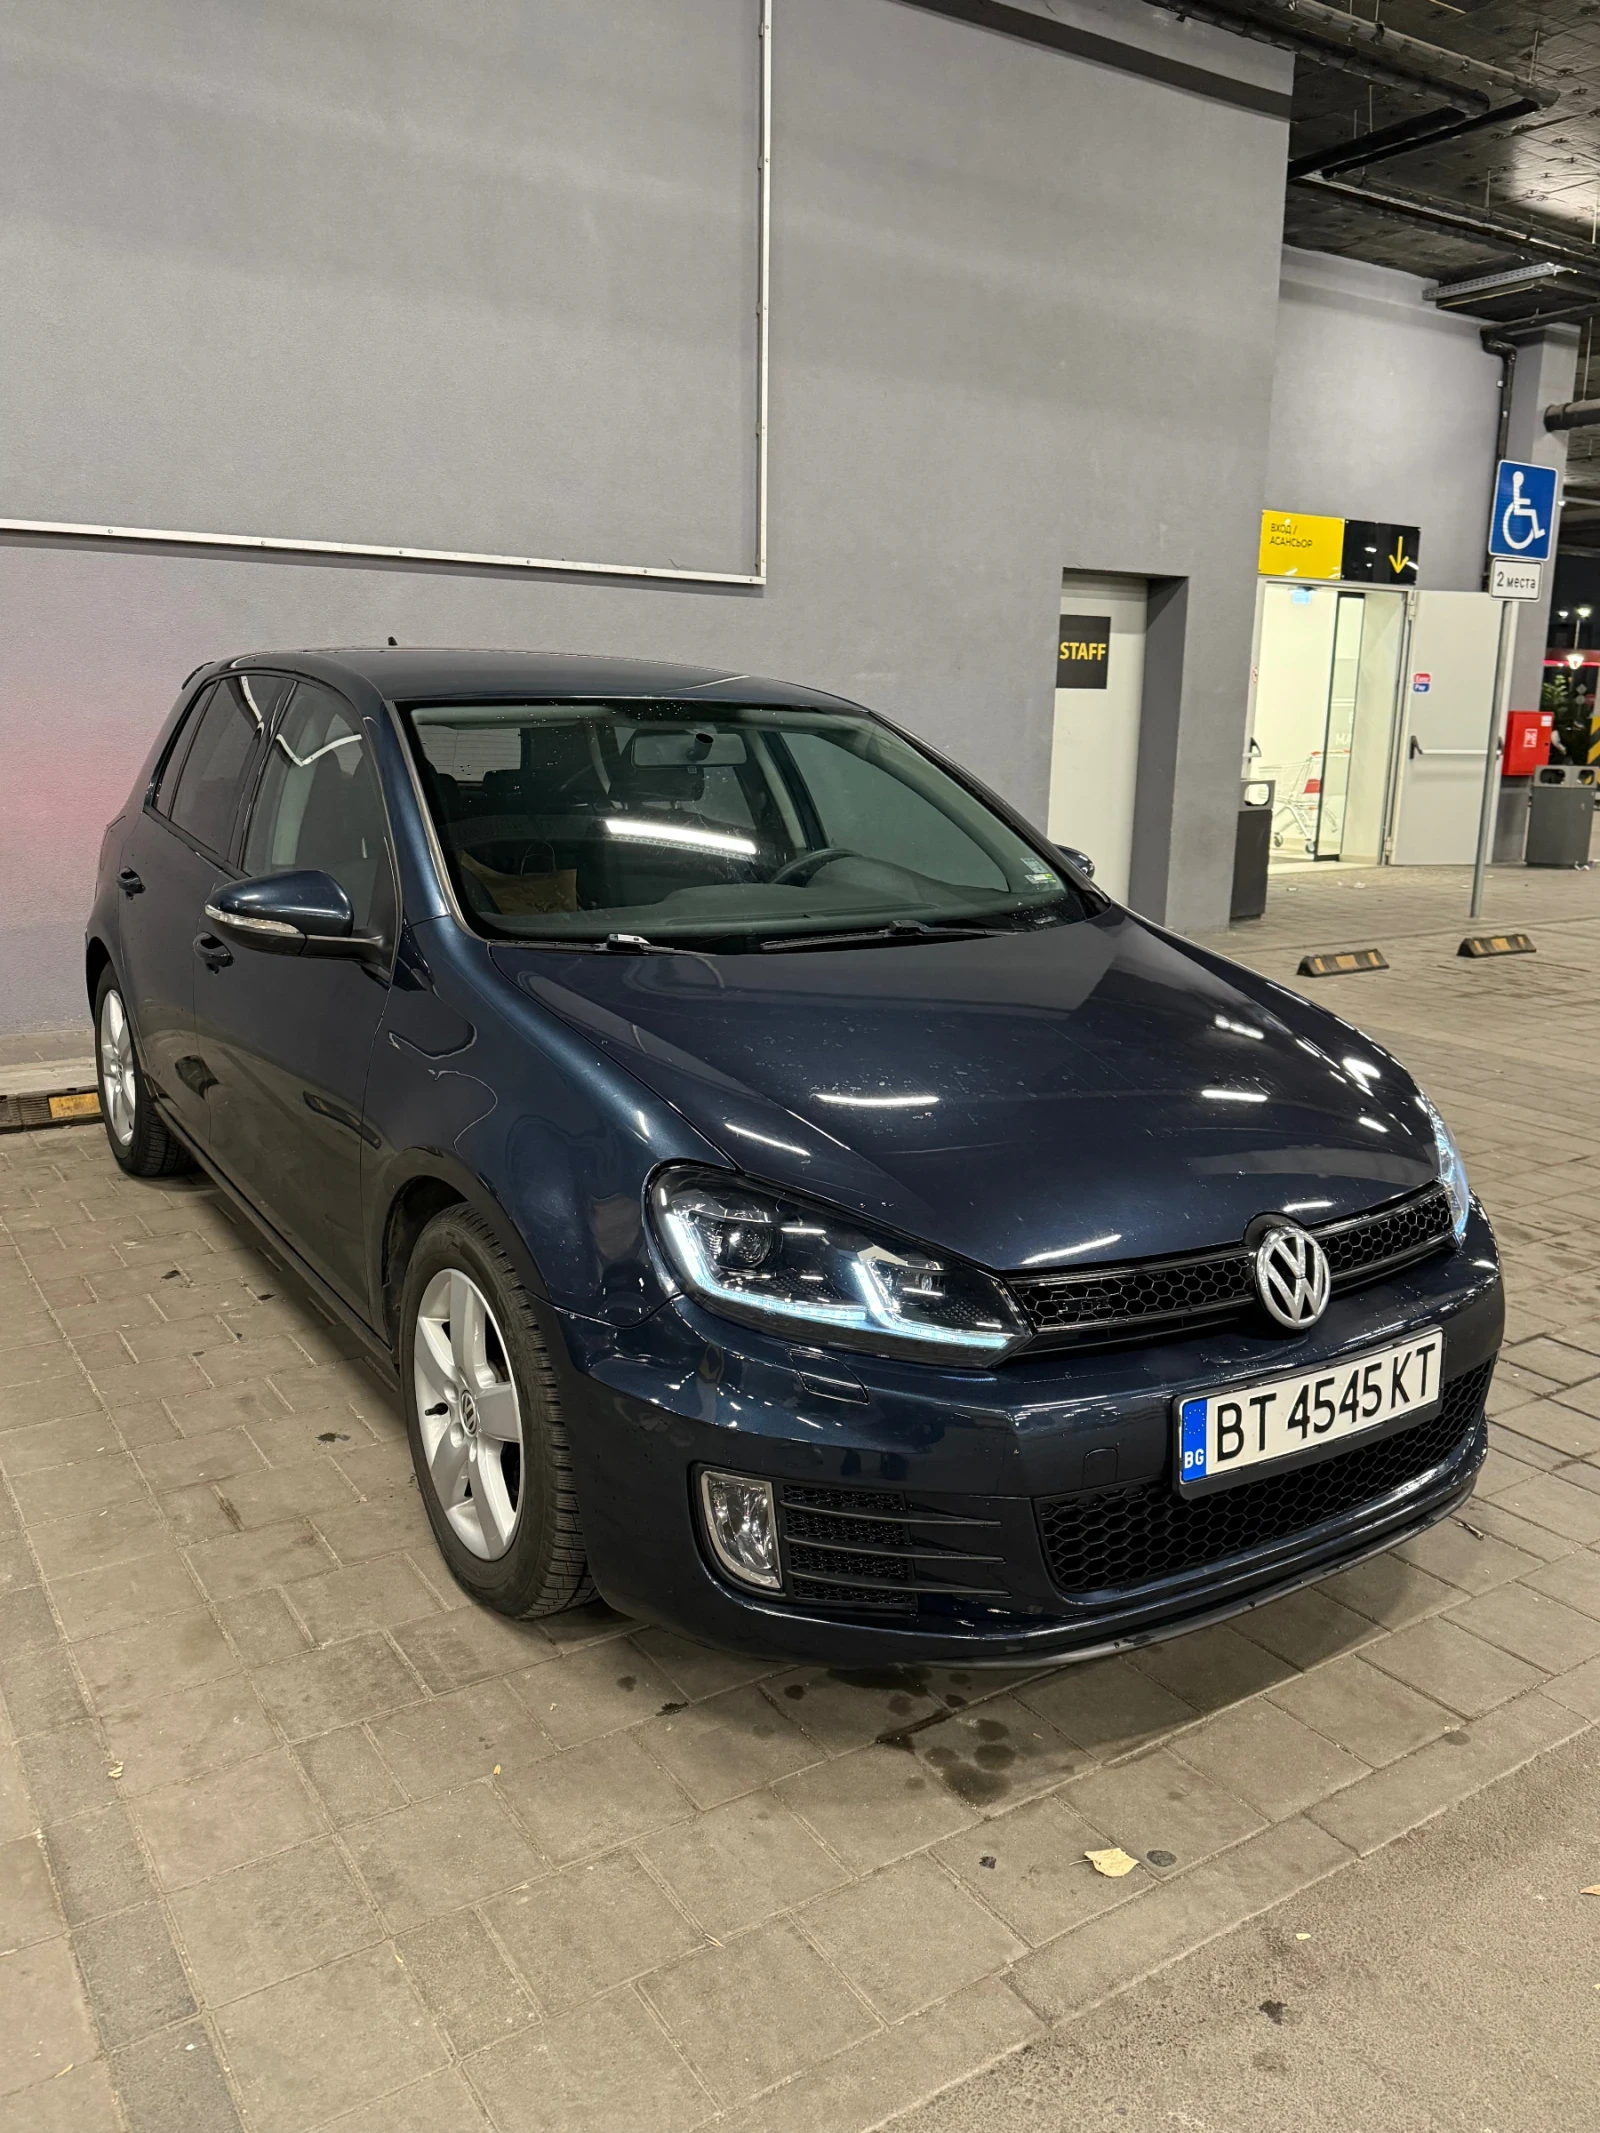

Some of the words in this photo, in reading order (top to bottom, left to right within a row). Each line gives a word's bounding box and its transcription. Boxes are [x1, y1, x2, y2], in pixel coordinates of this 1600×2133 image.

[1271, 523, 1291, 535] ВХОД
[1269, 536, 1313, 548] АСАНСЬОР
[1497, 571, 1504, 587] 2
[1506, 577, 1536, 589] места
[1059, 641, 1106, 660] STAFF
[1217, 1393, 1277, 1462] BT
[1286, 1362, 1383, 1440] 4545
[1391, 1343, 1436, 1409] KT
[1184, 1448, 1205, 1469] BG
